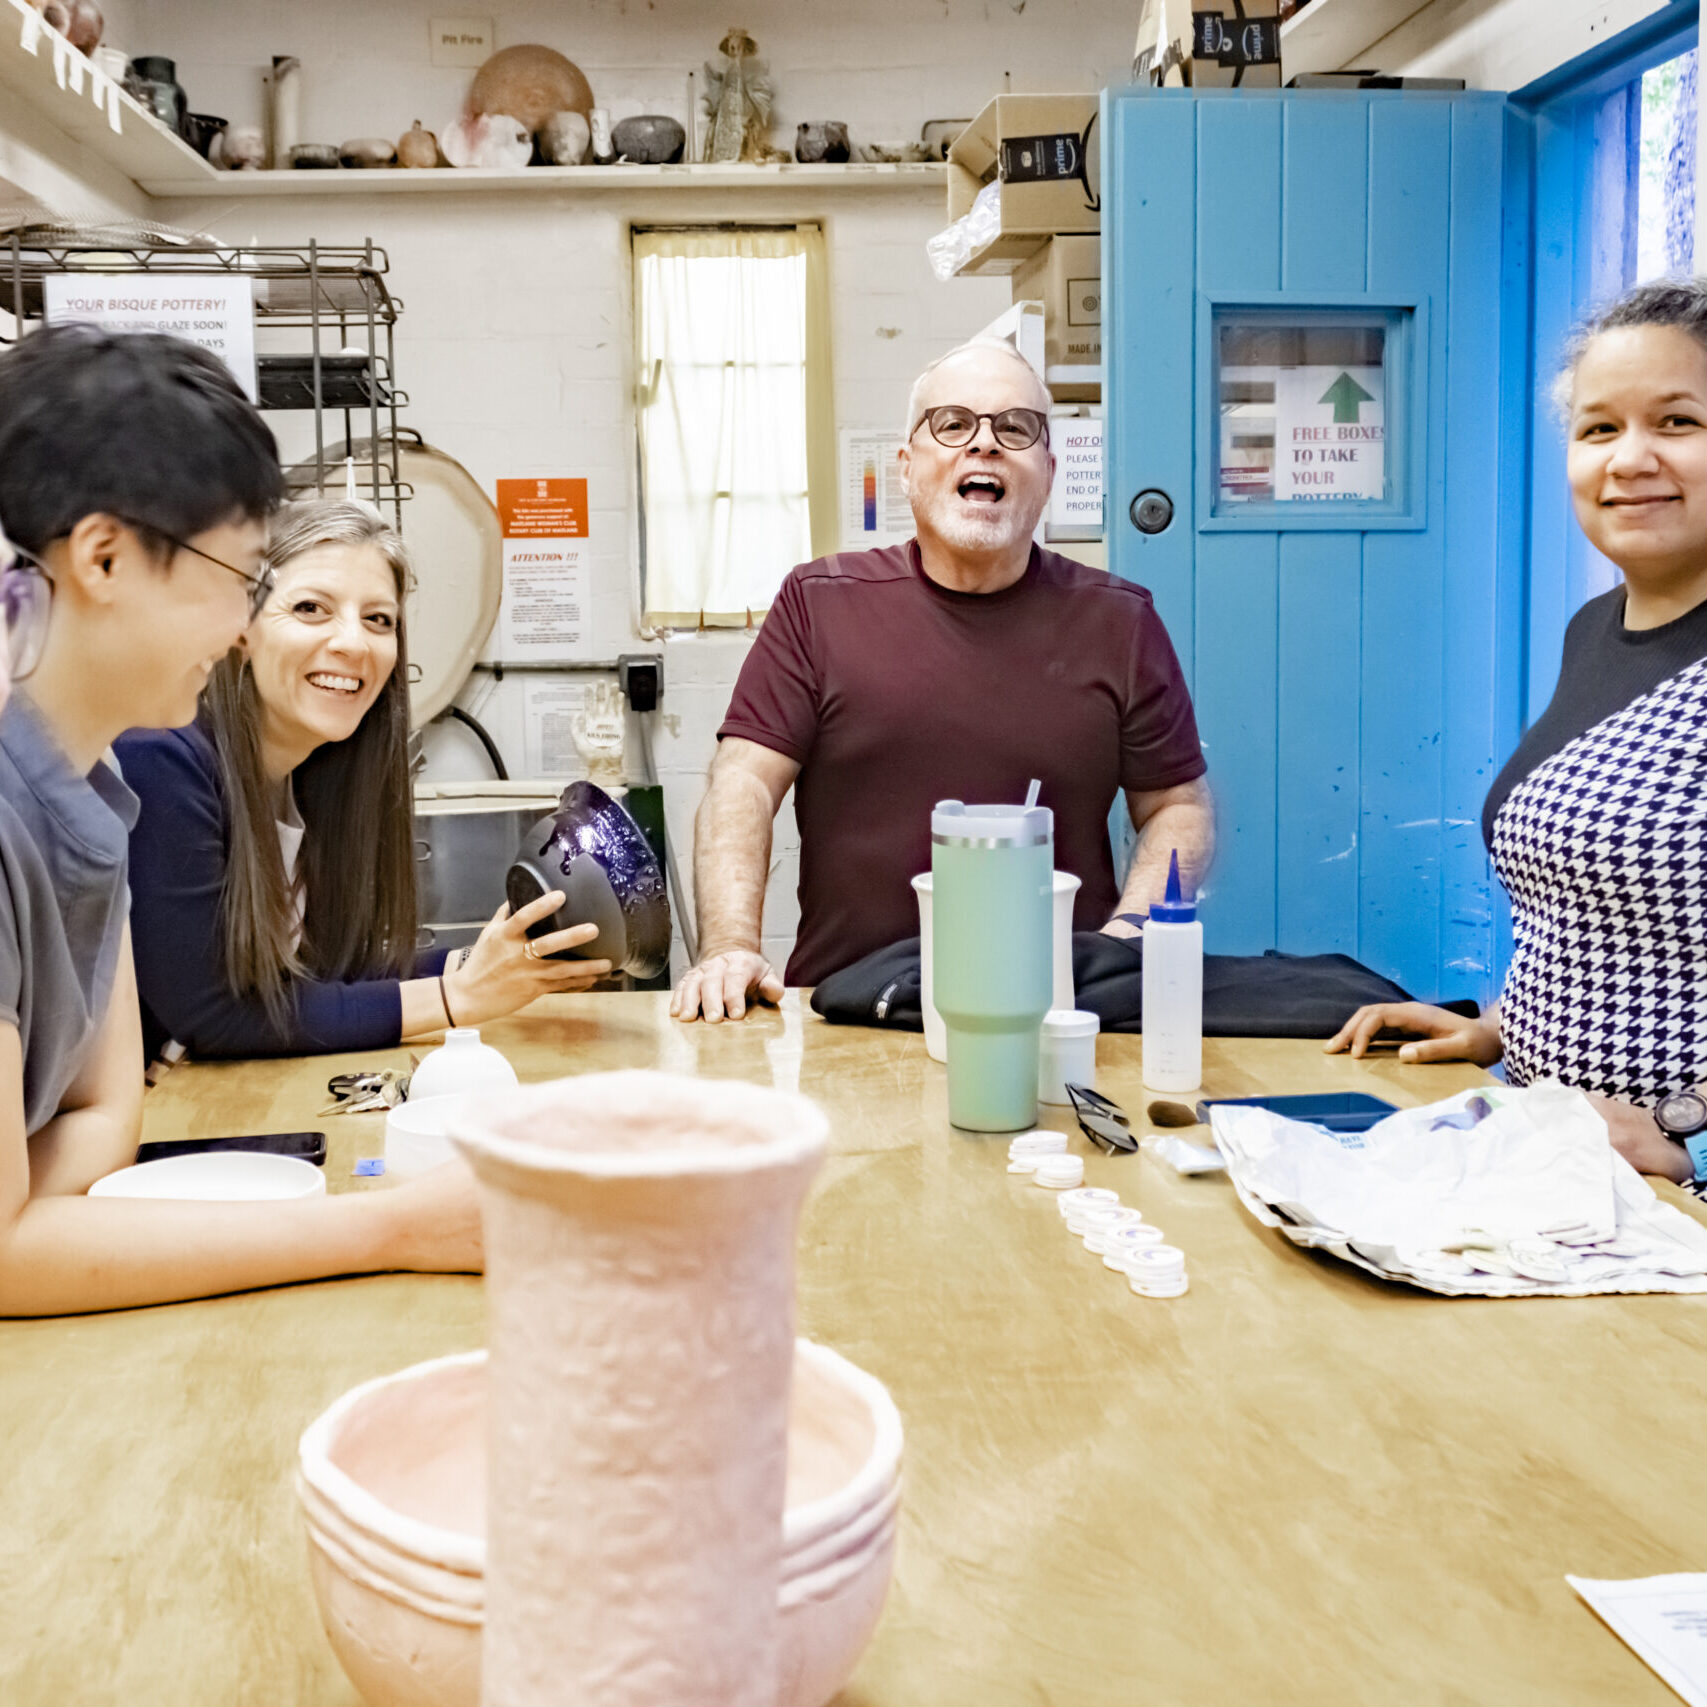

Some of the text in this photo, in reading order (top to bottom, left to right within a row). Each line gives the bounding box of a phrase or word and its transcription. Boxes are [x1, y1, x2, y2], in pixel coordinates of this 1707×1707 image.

[442, 34, 483, 45] Pit Fire
[1202, 16, 1214, 53] prime
[1250, 24, 1264, 60] prime
[1055, 139, 1069, 175] prime
[66, 299, 226, 312] YOUR BISQUE POTTERY!
[158, 321, 190, 329] GLAZE
[193, 321, 227, 330] SOON!
[197, 339, 225, 348] DAYS
[1068, 344, 1091, 353] MADE
[1292, 427, 1333, 440] FREE
[1066, 436, 1089, 446] HOT
[1066, 455, 1098, 463] PLEASE
[1292, 448, 1358, 463] TO TAKE
[1292, 471, 1334, 485] YOUR
[1066, 486, 1099, 495] END OF
[511, 552, 579, 562] ATTENTION !!!
